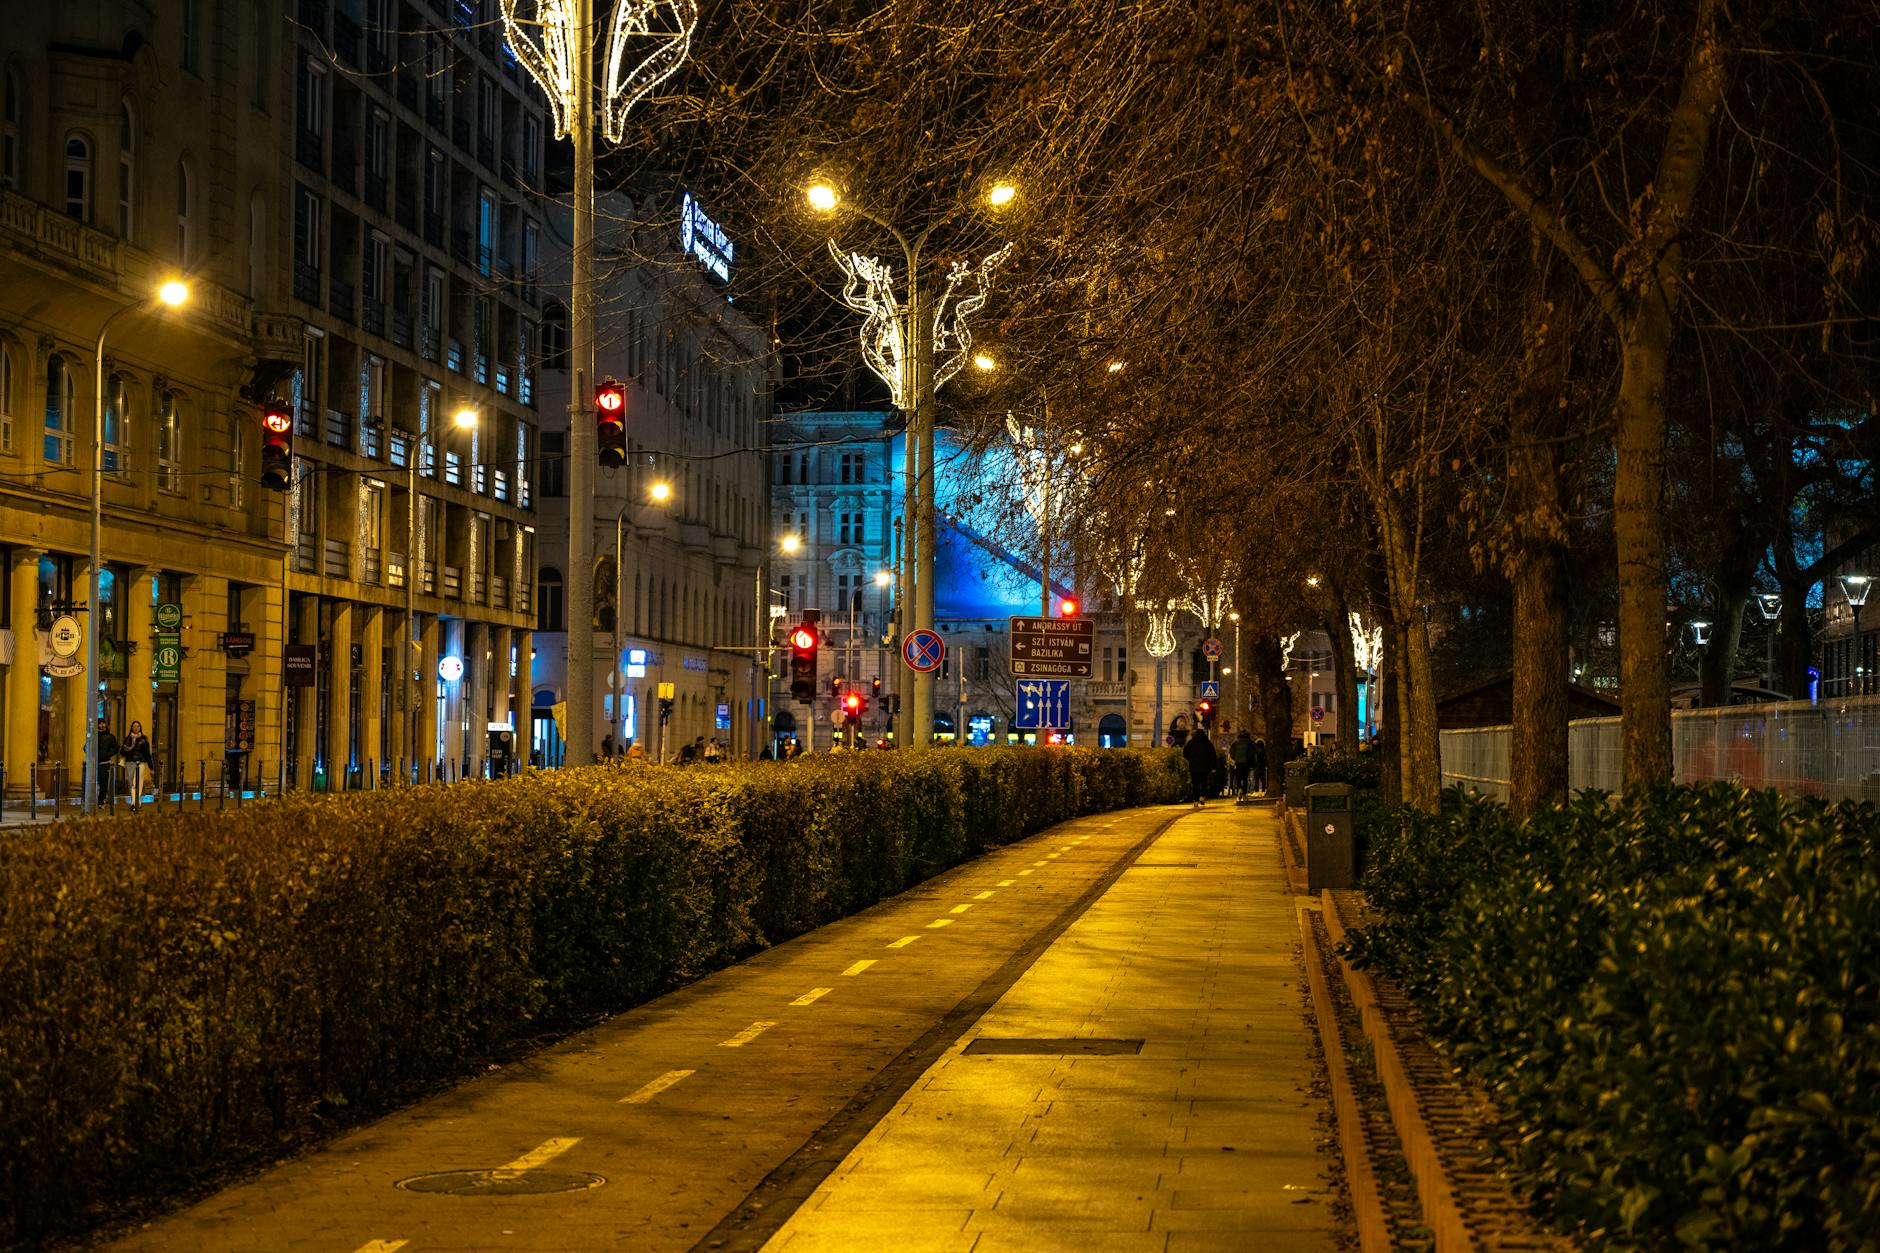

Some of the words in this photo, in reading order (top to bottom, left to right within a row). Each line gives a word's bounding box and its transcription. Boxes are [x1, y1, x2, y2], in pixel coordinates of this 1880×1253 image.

[1032, 621, 1071, 631] ANDRÁSSY
[1072, 621, 1082, 631] ÚT
[1049, 637, 1074, 647] ISTVÁN
[163, 649, 175, 666] R
[1031, 648, 1064, 658] BAZILIKA
[1031, 663, 1072, 673] ZSINAGÓGA
